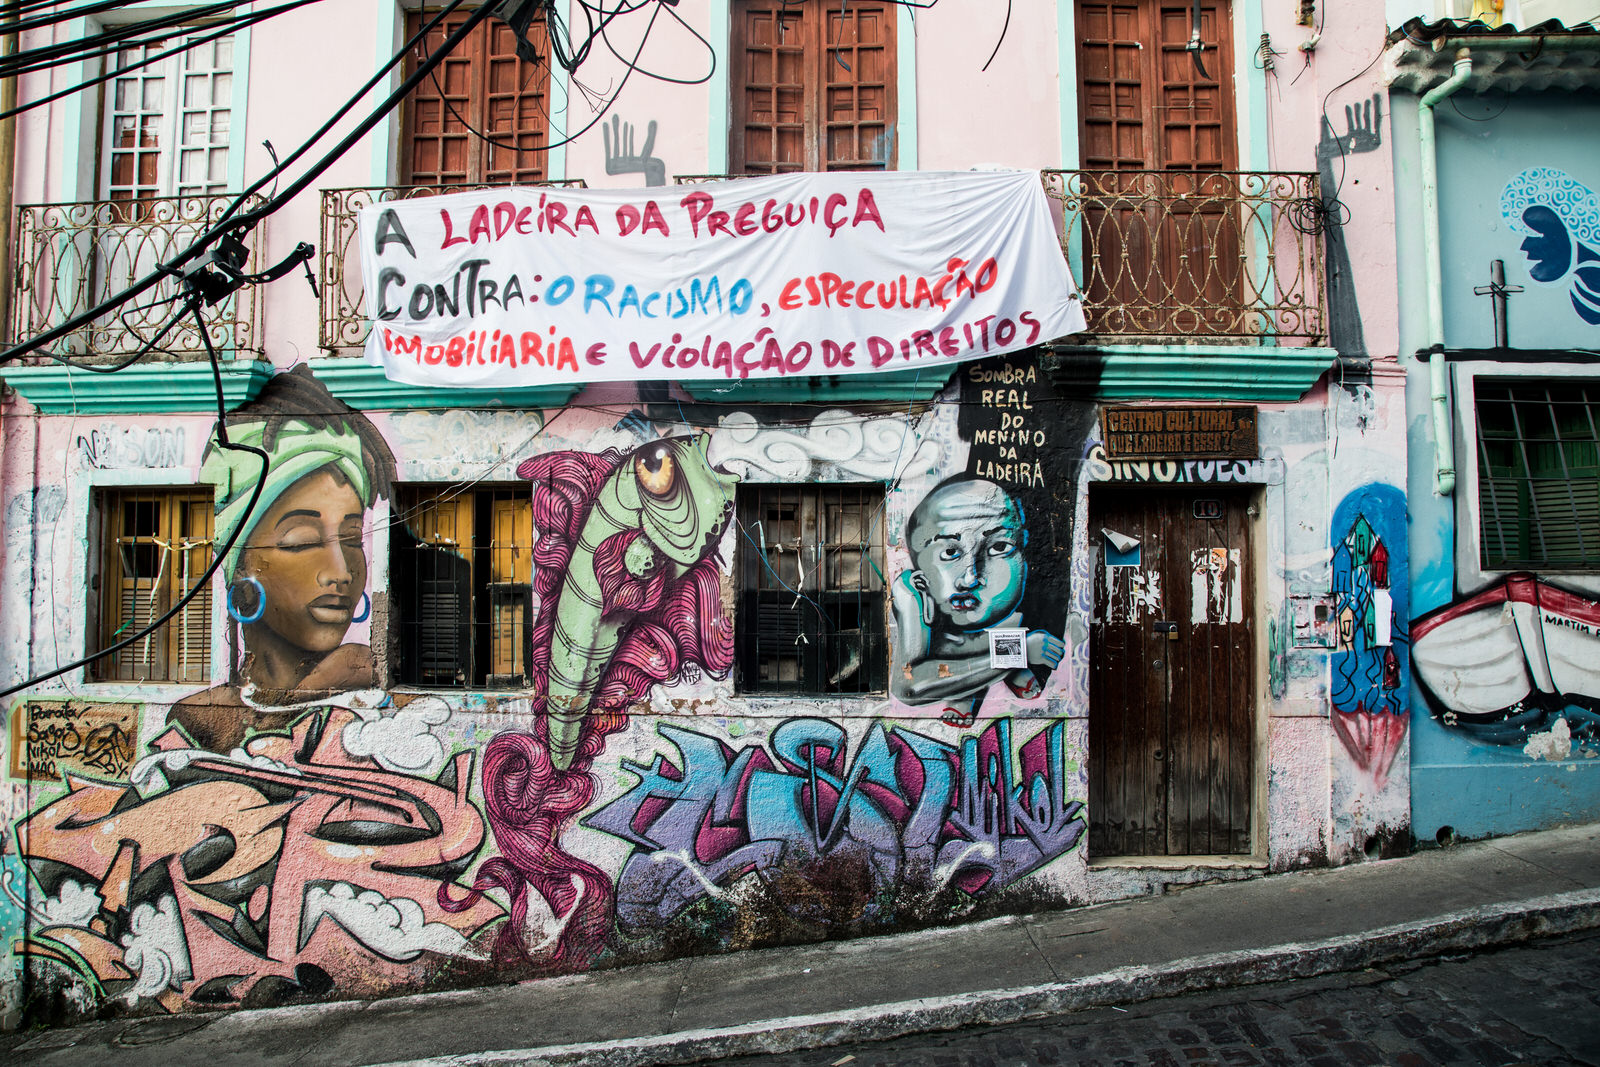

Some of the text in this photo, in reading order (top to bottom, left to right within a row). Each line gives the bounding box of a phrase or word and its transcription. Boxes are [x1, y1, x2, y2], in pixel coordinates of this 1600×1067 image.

[375, 208, 417, 259] A
[615, 201, 670, 238] DA
[680, 188, 886, 239] PREGUIÇA
[544, 275, 575, 307] O
[778, 257, 999, 312] ESPECULAÇÃO
[821, 338, 856, 369] DE
[866, 311, 1042, 369] DIREITOS
[968, 362, 1036, 386] SOMBRA
[981, 389, 1033, 410] REAL
[1001, 412, 1025, 431] DO
[1108, 409, 1236, 432] CENTRO CULTURAL
[974, 429, 1046, 447] MENINO
[1109, 434, 1133, 457] QUE
[1134, 432, 1182, 453] LADEIRA
[999, 446, 1018, 460] DA
[1545, 614, 1590, 635] MARTIM
